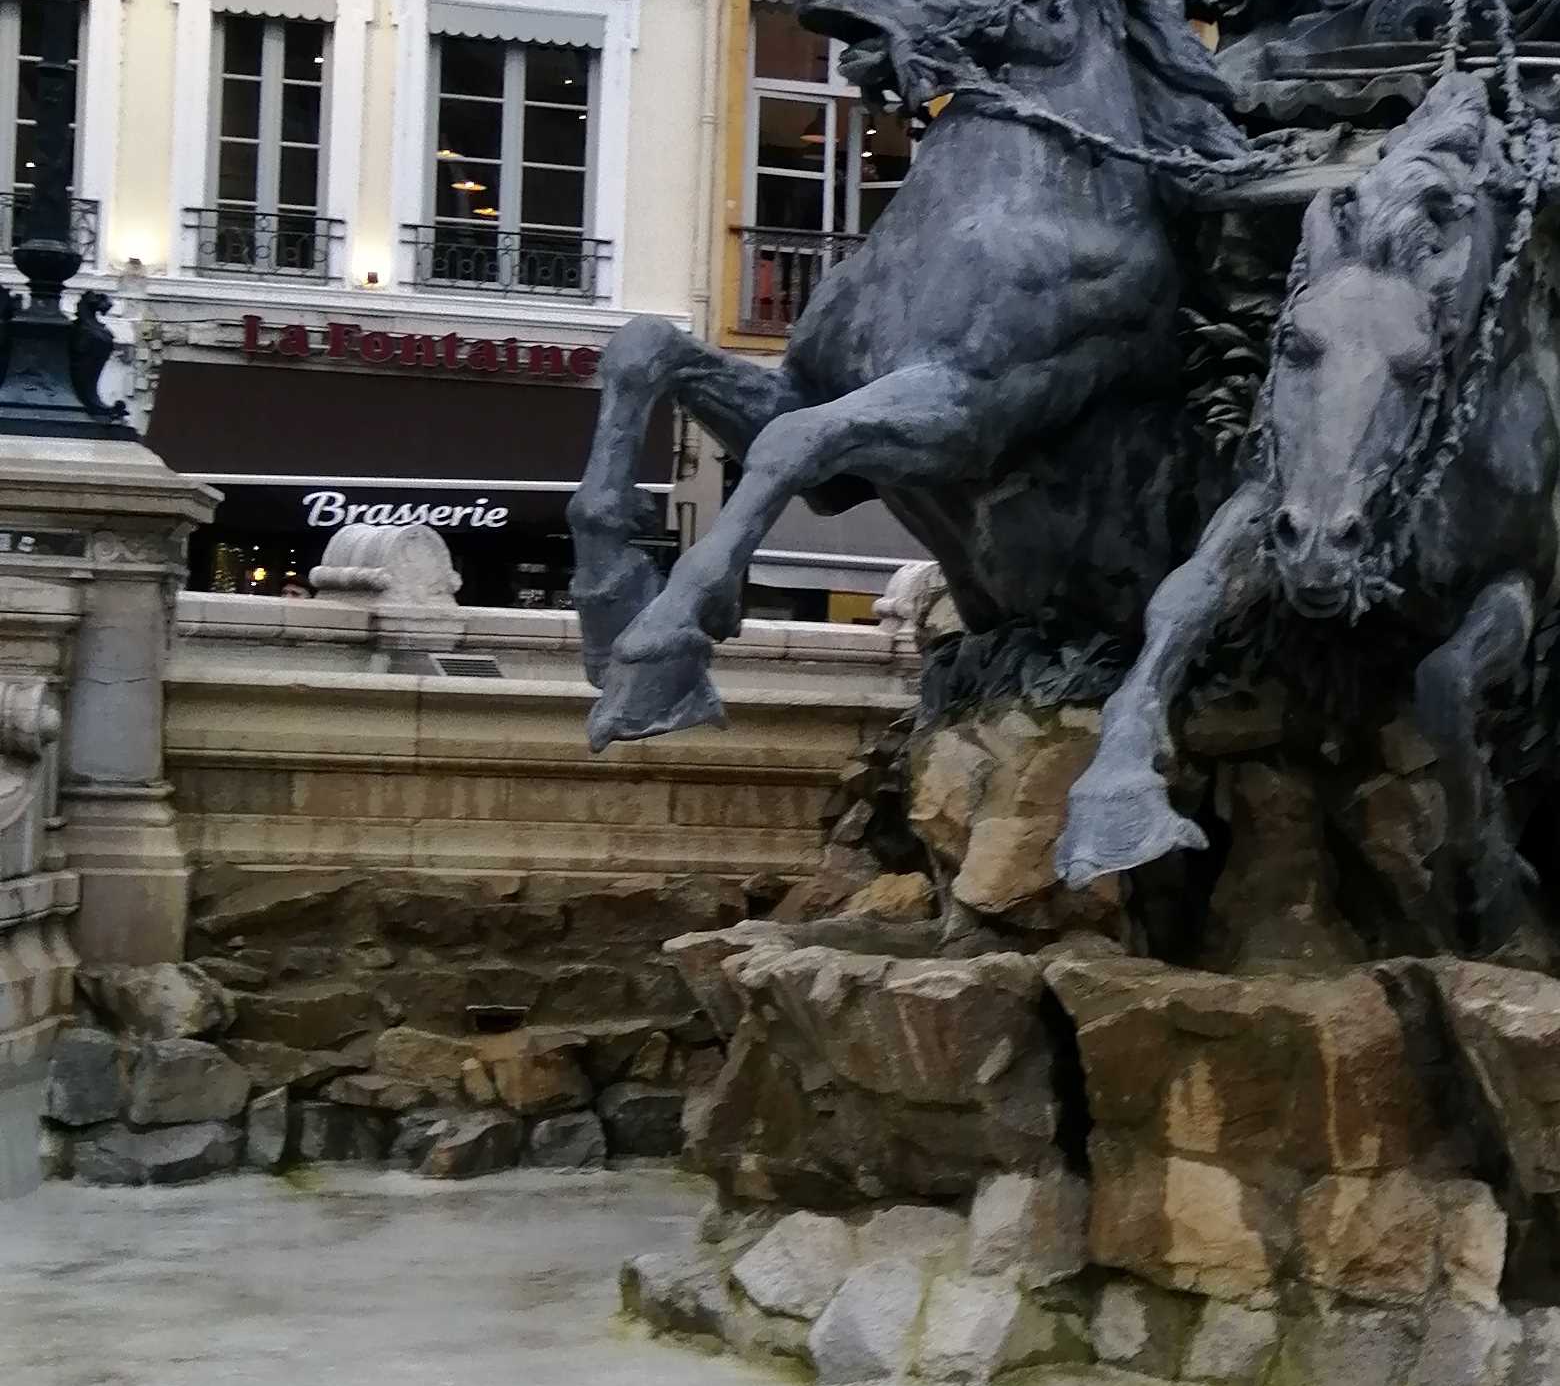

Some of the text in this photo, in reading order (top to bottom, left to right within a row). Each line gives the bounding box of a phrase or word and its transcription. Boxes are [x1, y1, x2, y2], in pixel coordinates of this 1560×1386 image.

[241, 313, 602, 378] La Fontaine
[302, 490, 510, 528] Brasserie
